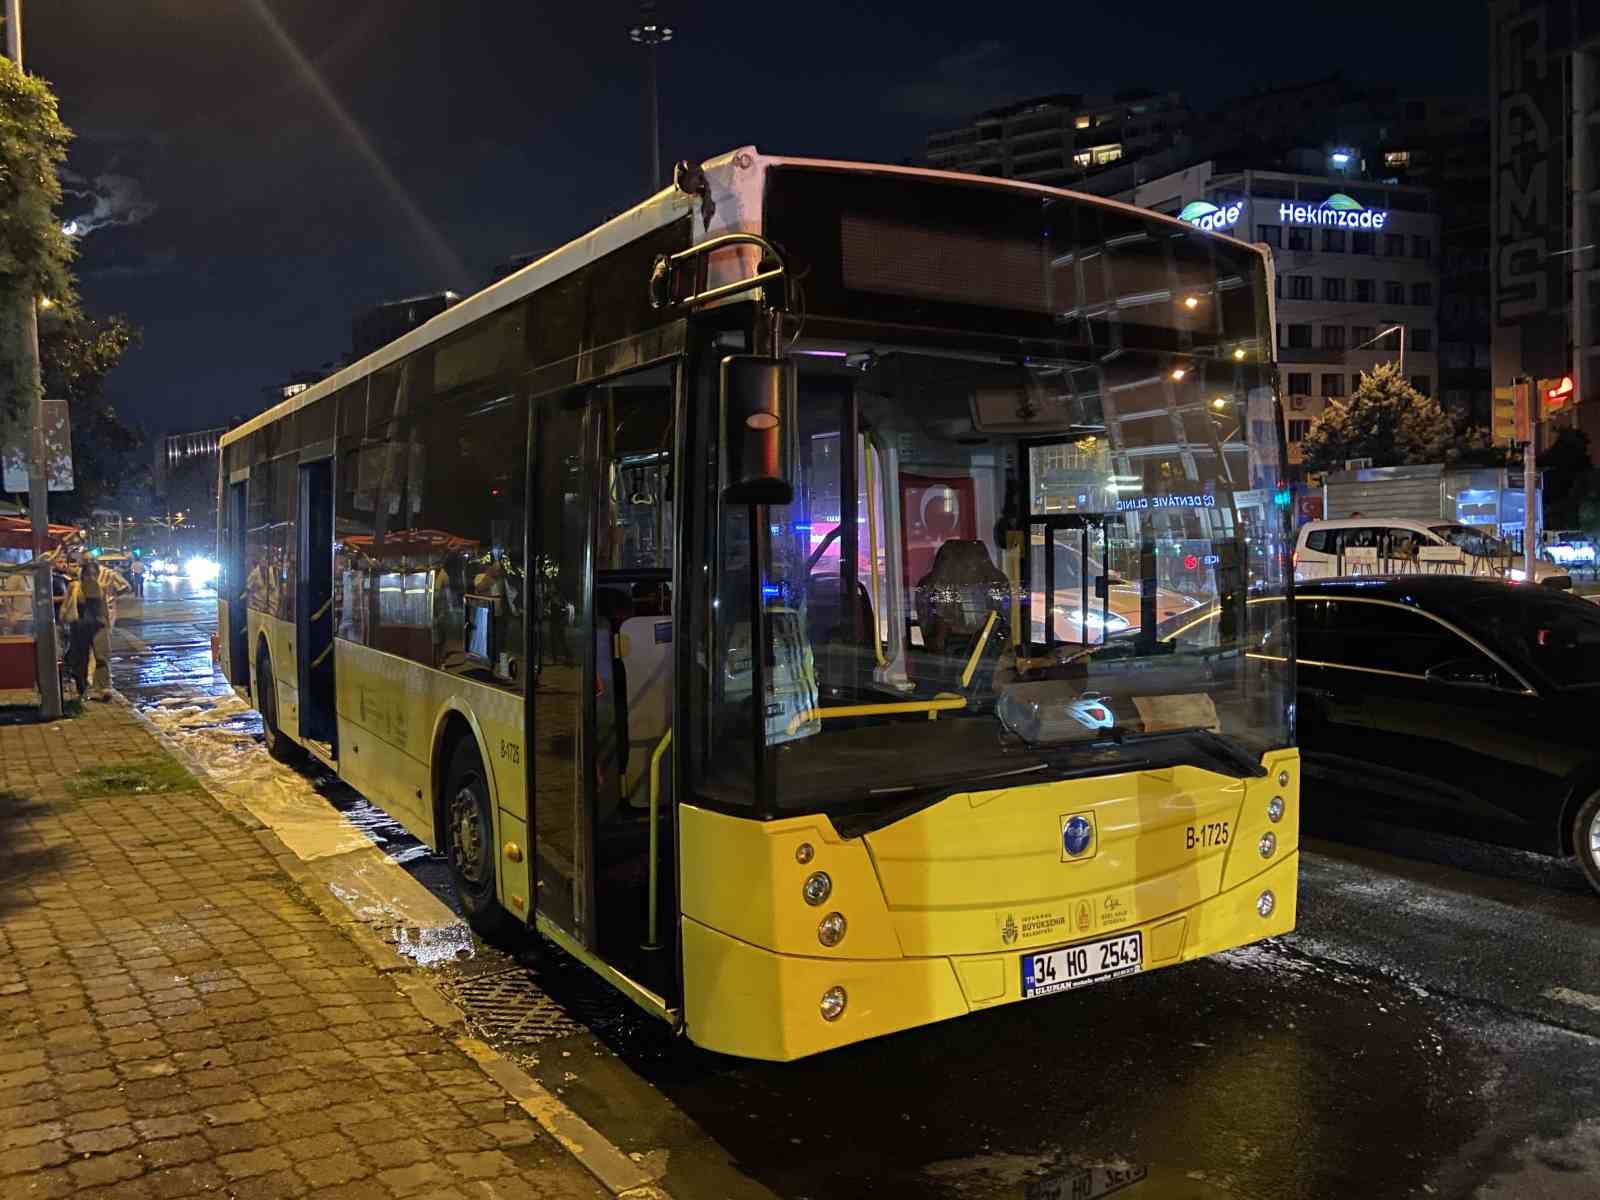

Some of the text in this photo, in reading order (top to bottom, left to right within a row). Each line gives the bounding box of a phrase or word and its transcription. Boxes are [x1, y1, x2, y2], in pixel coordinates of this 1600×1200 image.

[1279, 203, 1386, 228] Hekimzade
[501, 738, 520, 764] B-1725
[1186, 822, 1229, 849] B-1725
[1035, 956, 1056, 984] 34
[1100, 938, 1139, 970] 2543
